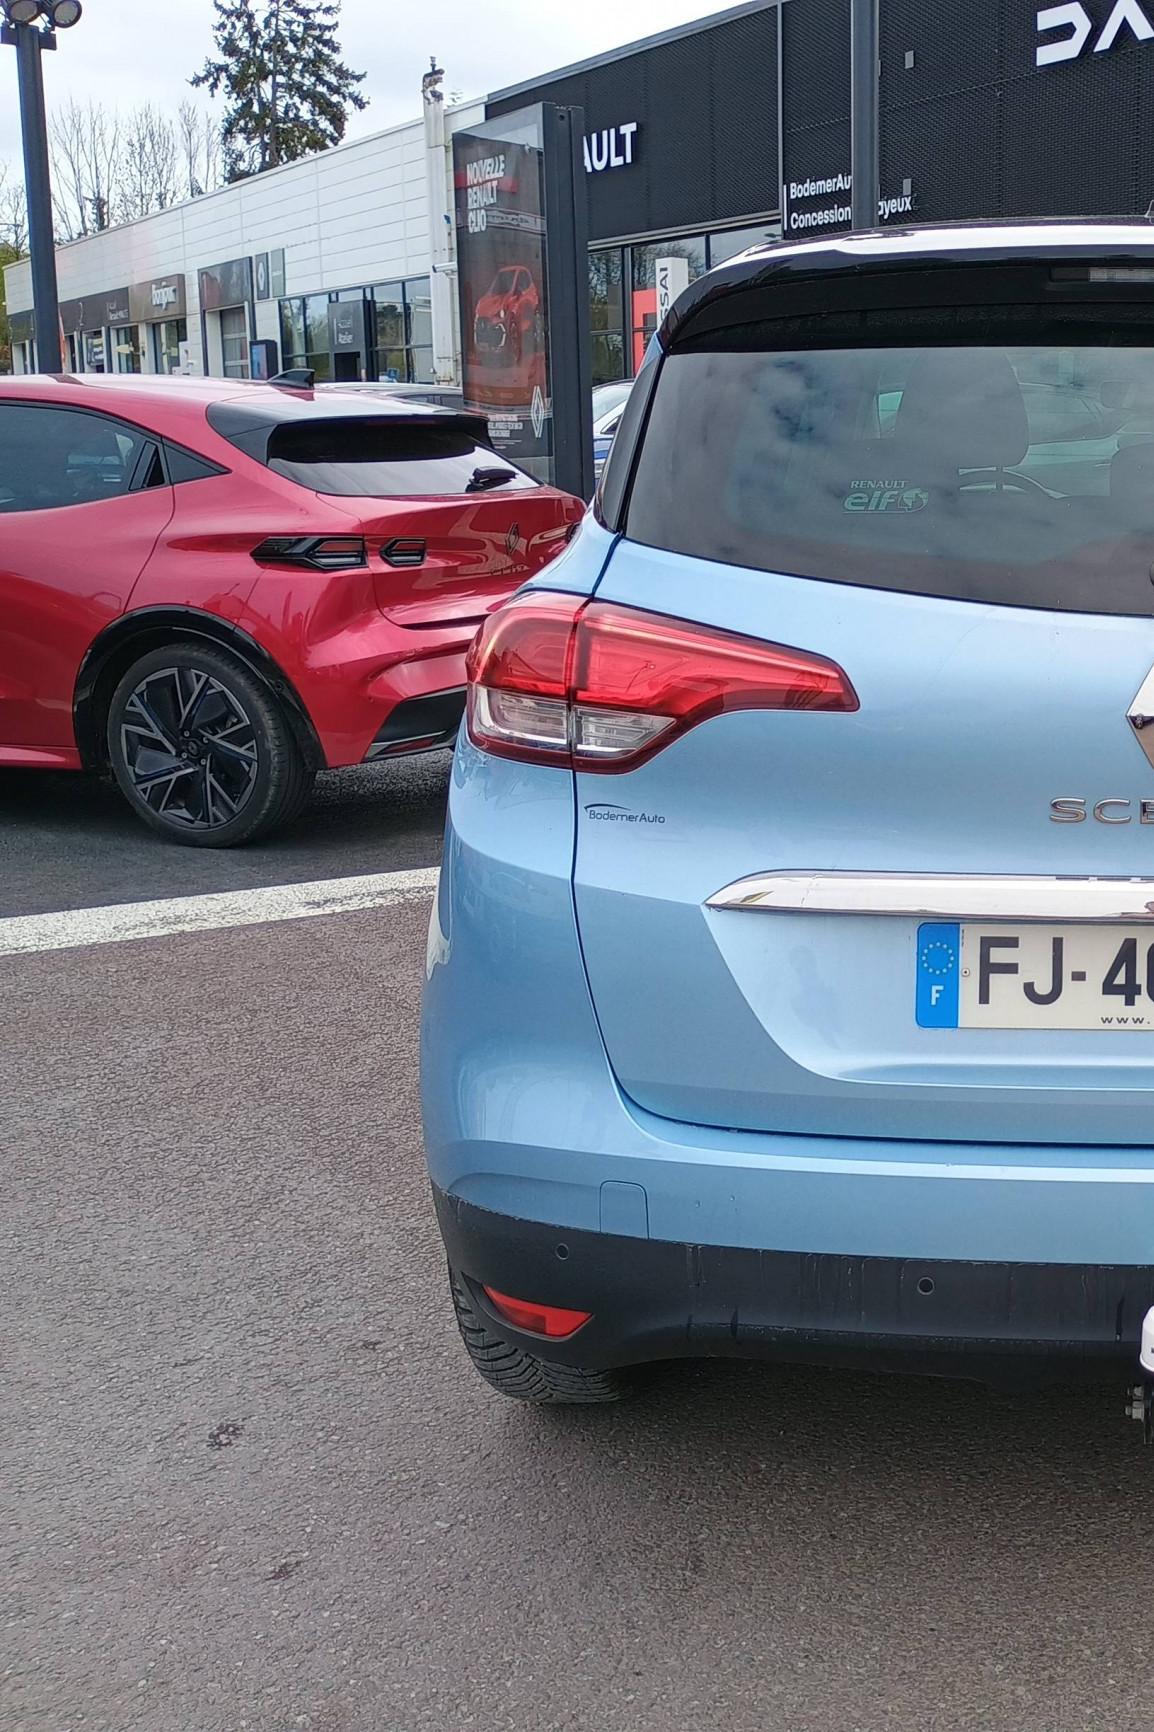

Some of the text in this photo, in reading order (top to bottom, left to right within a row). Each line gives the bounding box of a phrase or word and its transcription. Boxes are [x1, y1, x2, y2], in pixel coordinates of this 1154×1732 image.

[583, 122, 637, 173] AULT
[789, 173, 852, 199] BodemerAu
[878, 196, 912, 219] ayeux
[468, 209, 487, 233] CLIO
[659, 266, 670, 321] SSAI
[850, 480, 908, 489] RENAULT
[844, 490, 899, 511] elf
[589, 810, 665, 823] BodemerAuto
[931, 985, 944, 1006] F
